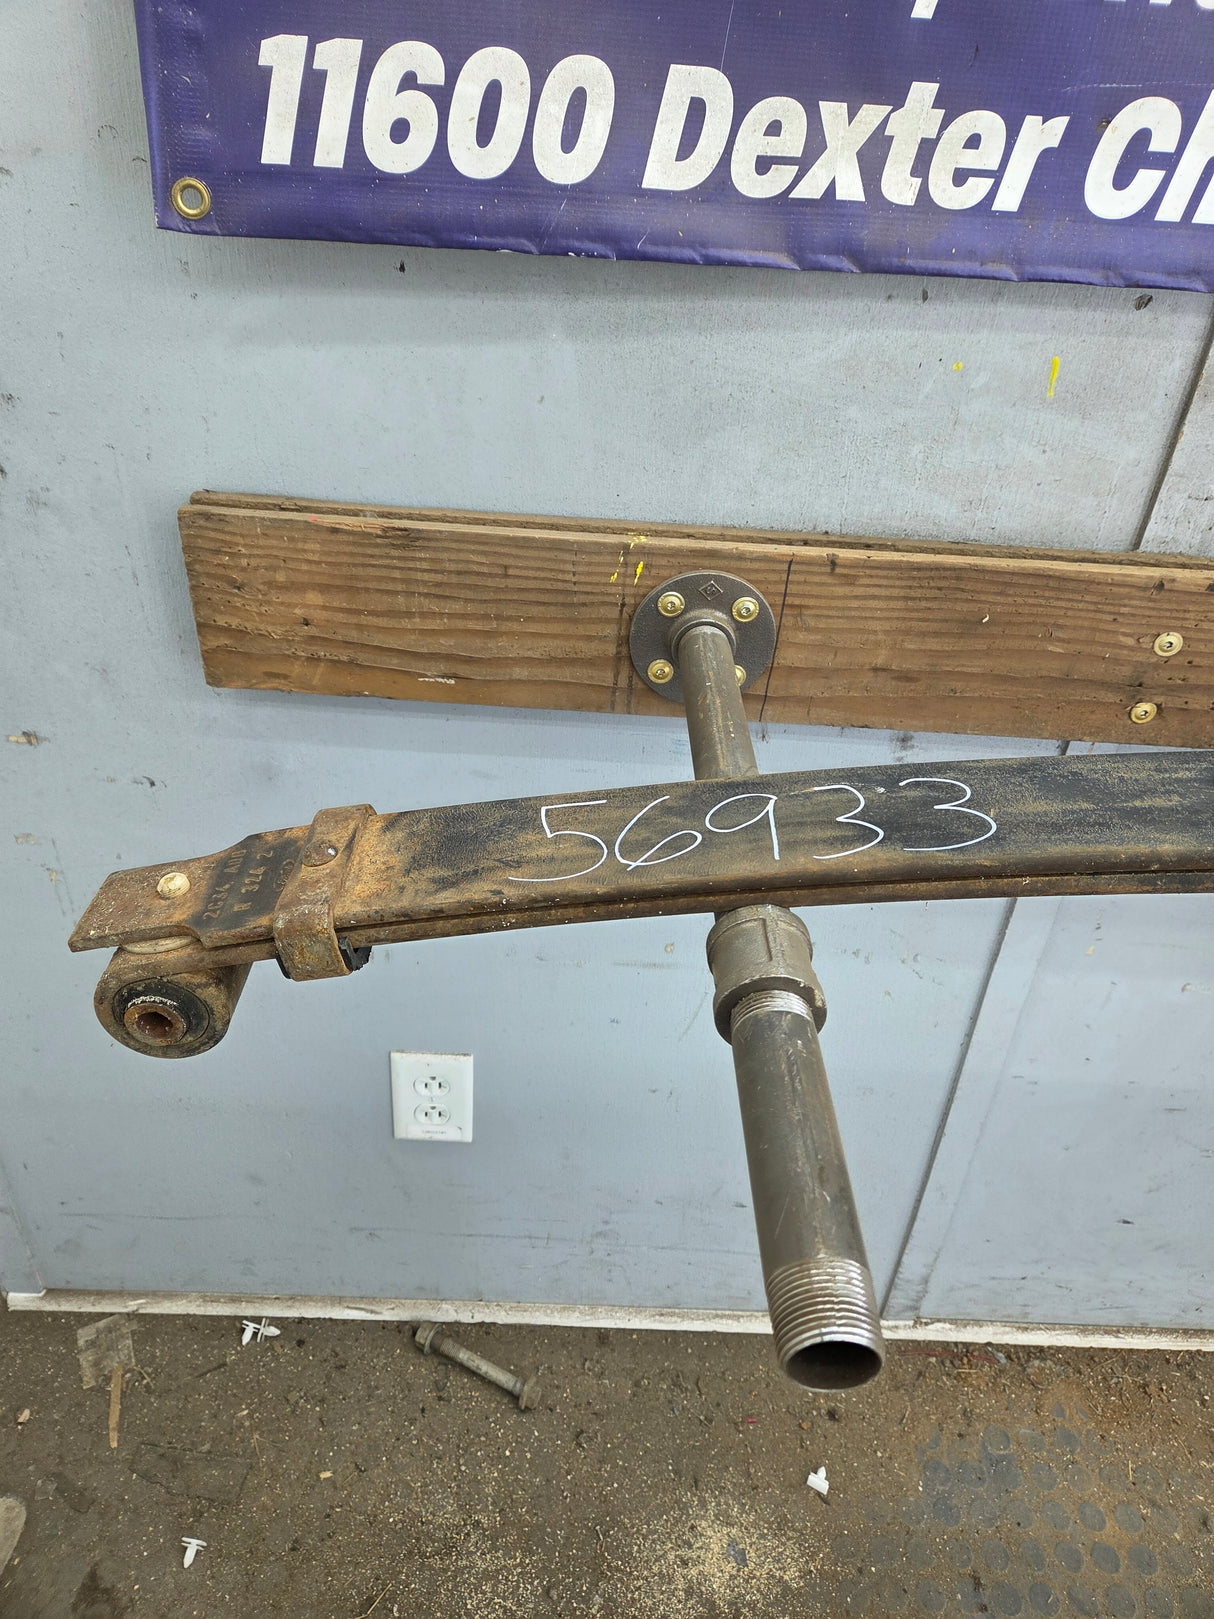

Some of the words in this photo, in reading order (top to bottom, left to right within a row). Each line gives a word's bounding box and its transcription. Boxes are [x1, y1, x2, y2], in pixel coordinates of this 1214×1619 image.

[256, 33, 616, 188] 11600
[641, 63, 1071, 212] Dexter
[507, 777, 997, 882] 56933
